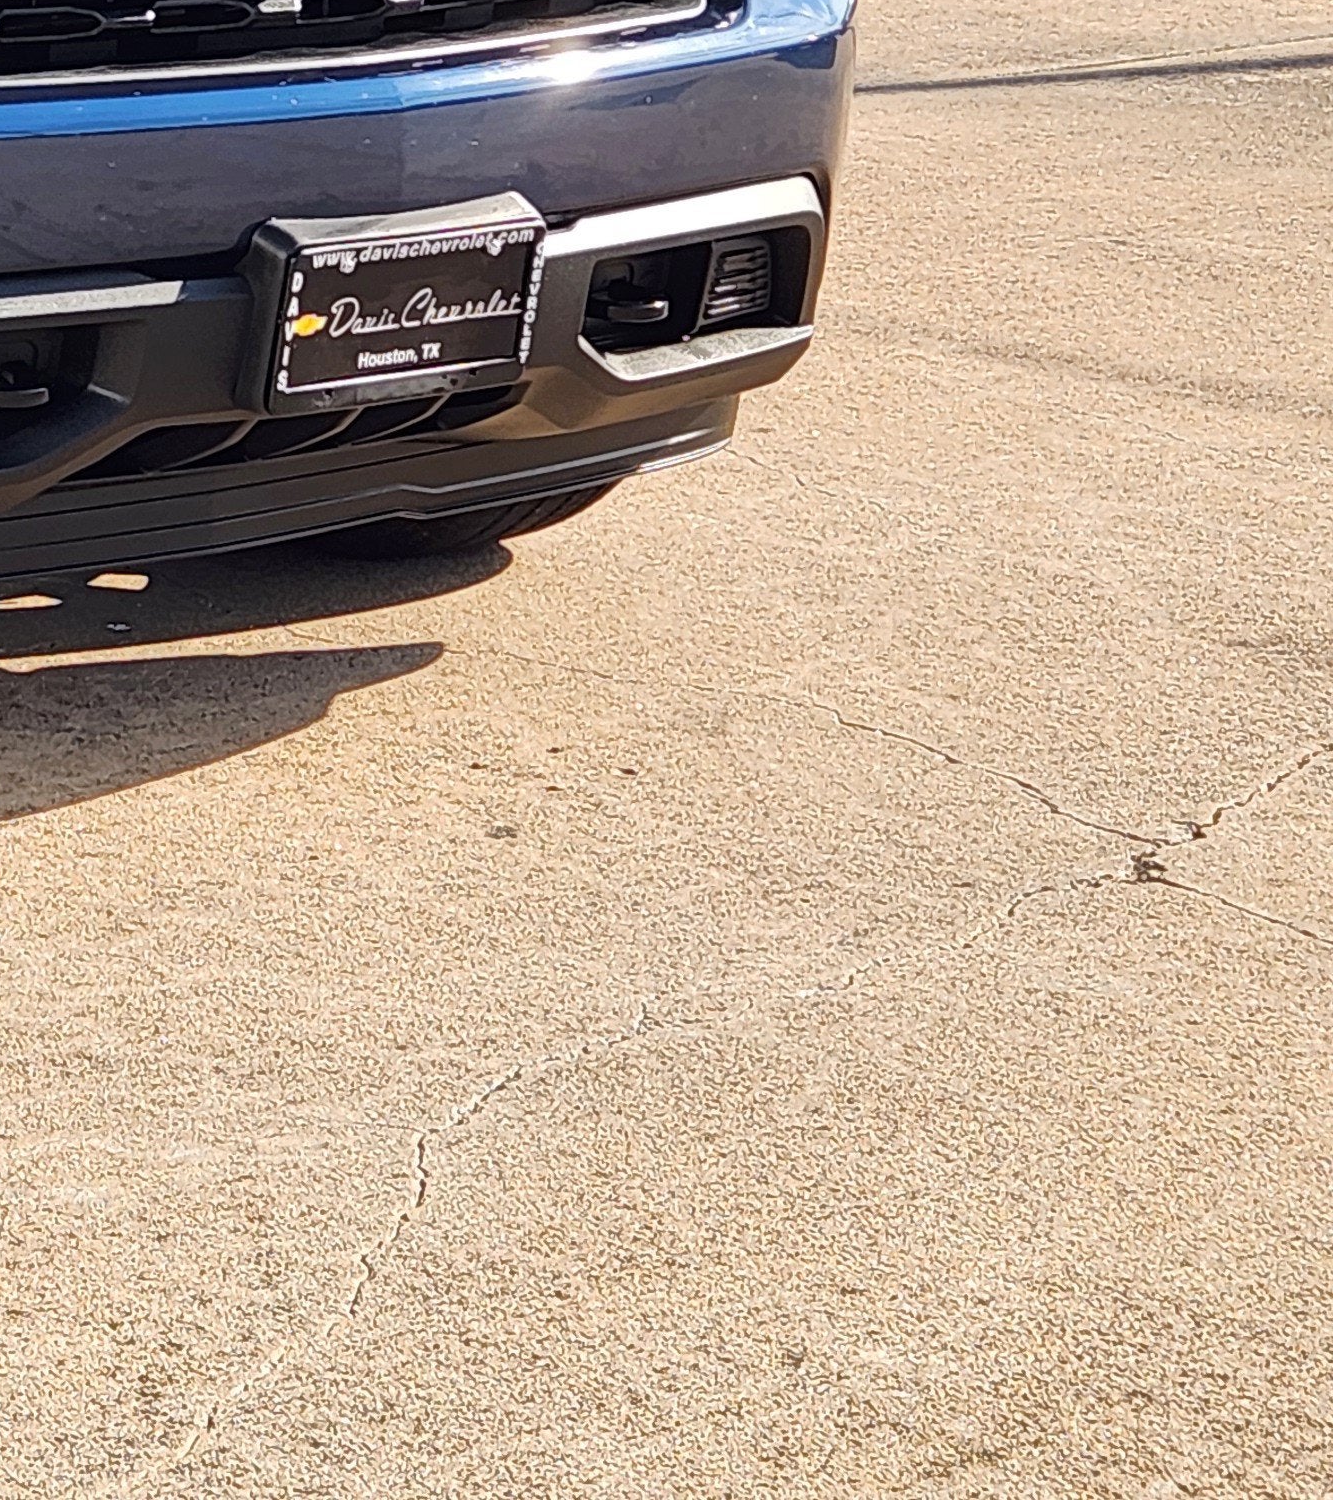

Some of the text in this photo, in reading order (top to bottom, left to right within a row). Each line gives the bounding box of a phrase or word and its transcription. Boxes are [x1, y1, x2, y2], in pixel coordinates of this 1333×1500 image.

[313, 230, 534, 271] www.davischevrolet.com
[329, 287, 522, 338] Davis Chevrolet
[519, 243, 545, 364] CHEVROLET
[277, 271, 304, 391] DAVIS
[358, 343, 441, 369] Houston, TX
